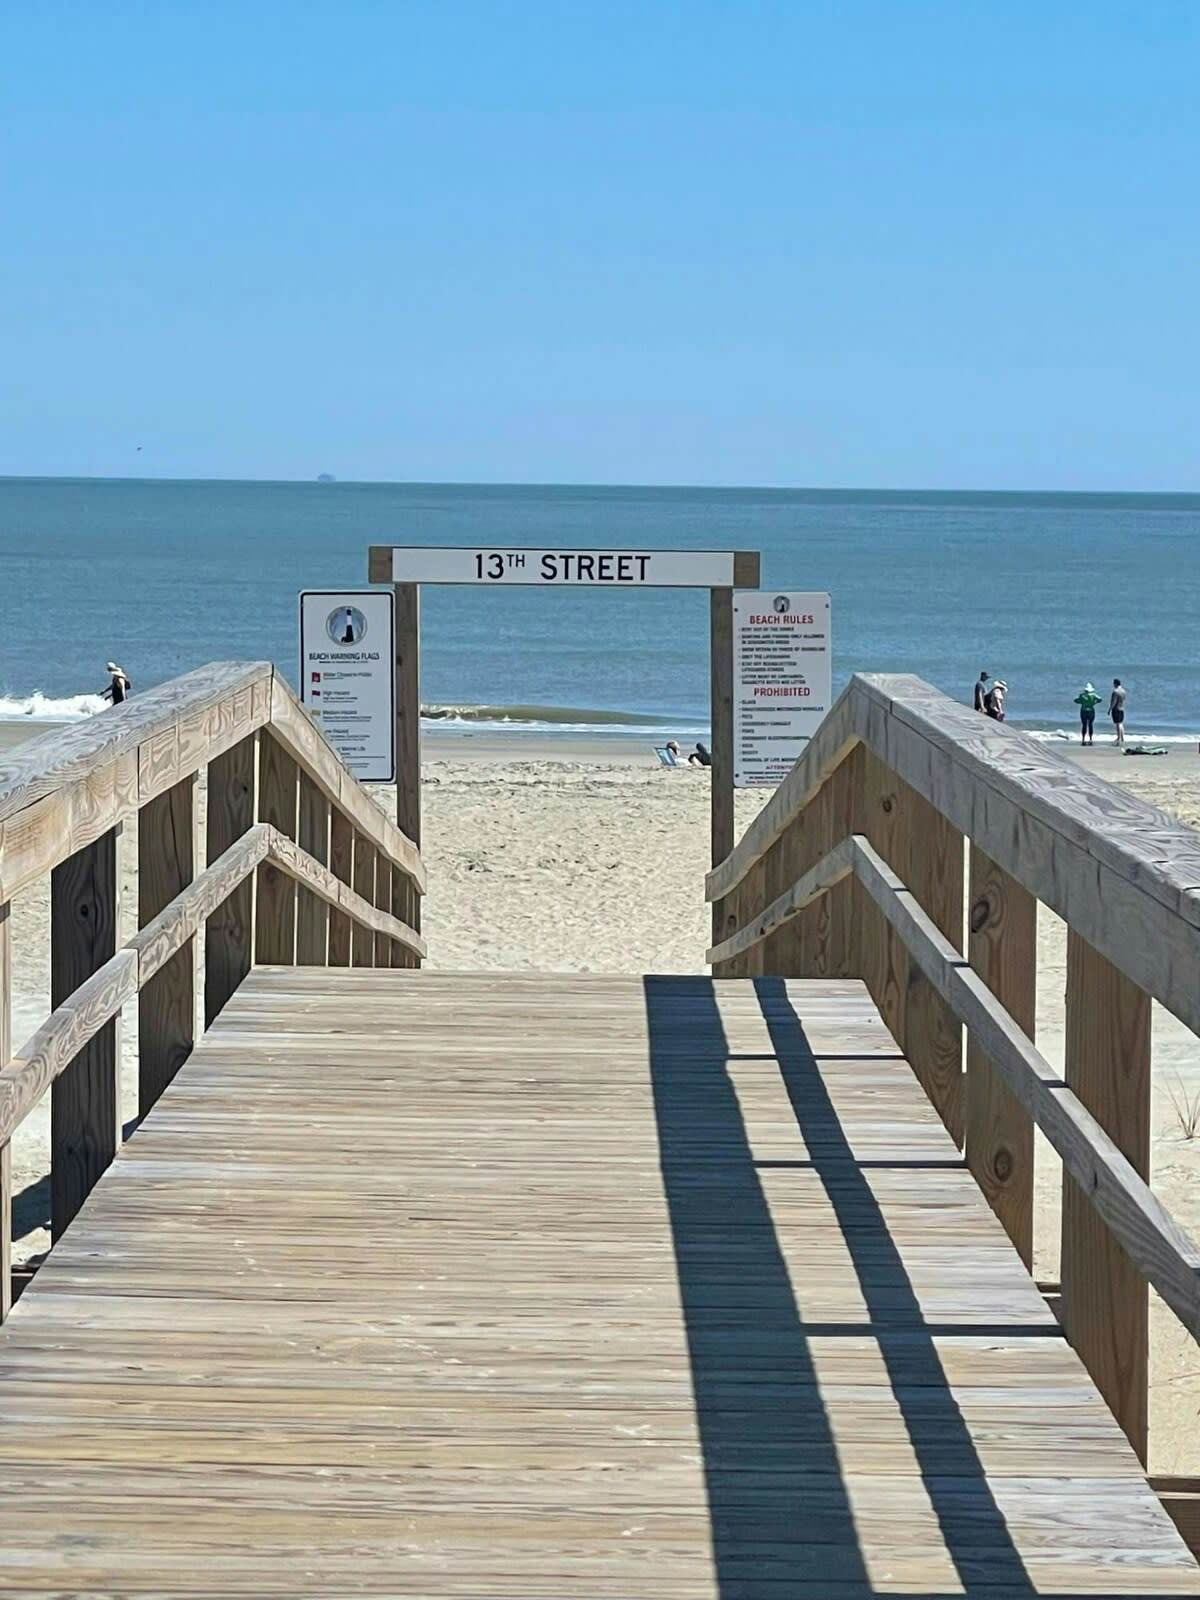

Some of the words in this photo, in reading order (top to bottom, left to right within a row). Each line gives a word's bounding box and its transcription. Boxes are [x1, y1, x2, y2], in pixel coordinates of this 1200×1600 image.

[475, 553, 526, 580] 13TH
[541, 554, 652, 582] STREET
[749, 615, 780, 625] BEACH
[783, 615, 814, 624] RULES
[309, 652, 329, 660] BEACH
[330, 652, 360, 660] WARNING
[361, 652, 380, 660] FLAGS
[753, 687, 810, 697] PROHIBITED
